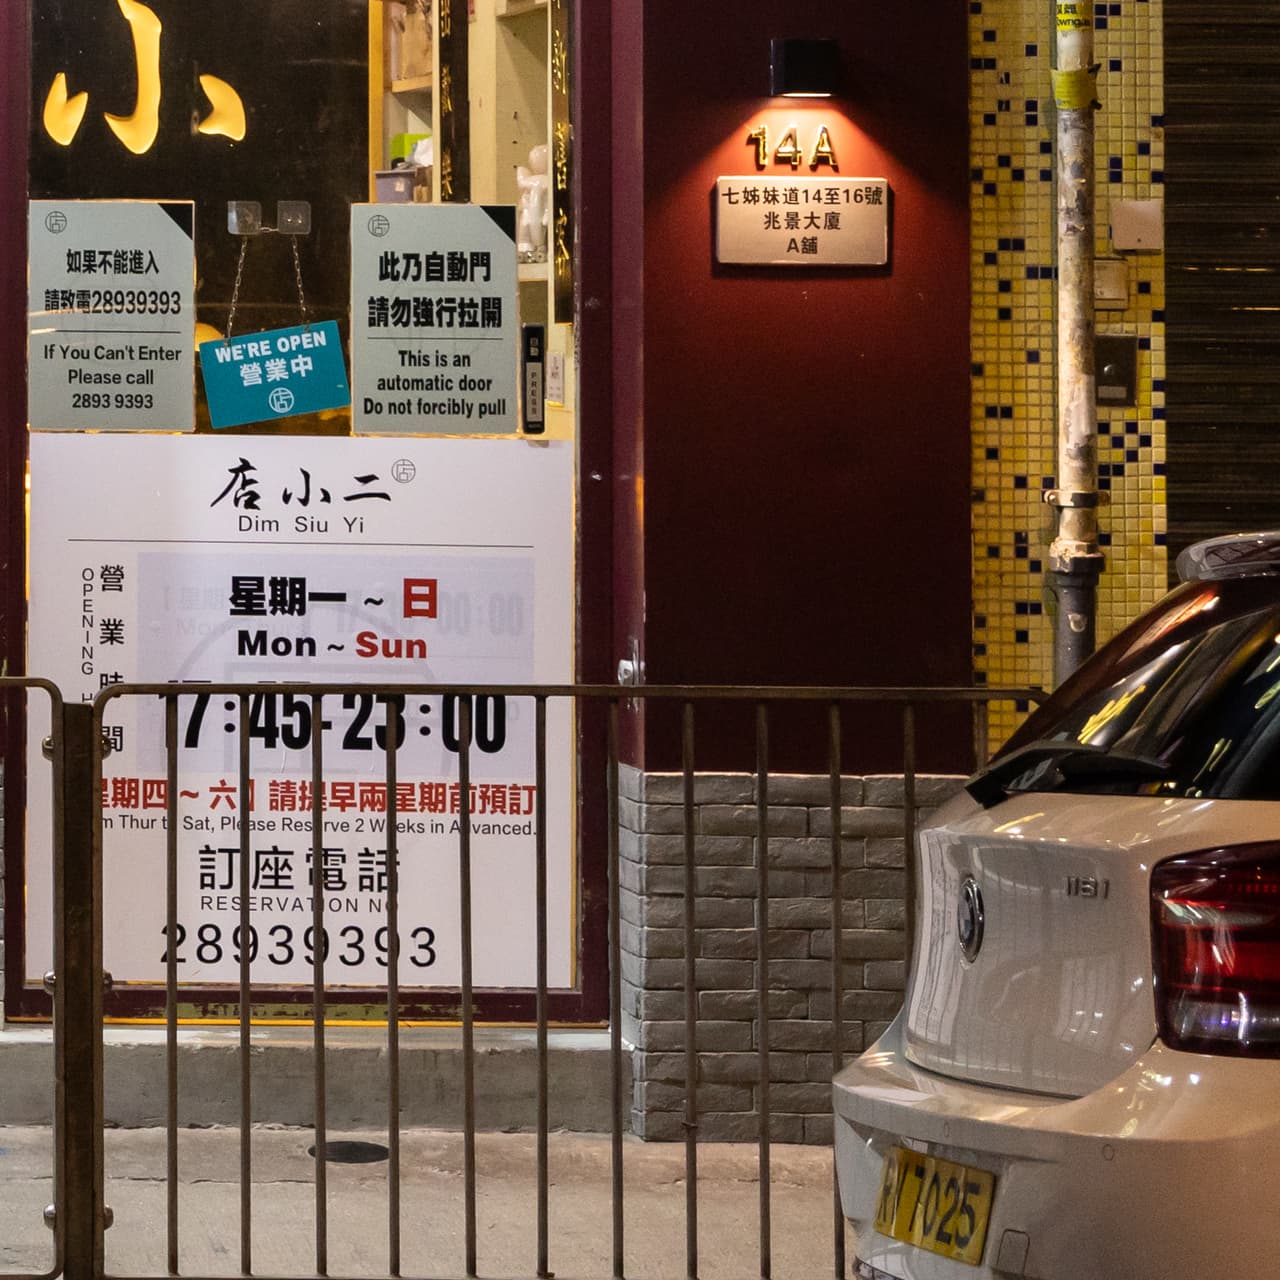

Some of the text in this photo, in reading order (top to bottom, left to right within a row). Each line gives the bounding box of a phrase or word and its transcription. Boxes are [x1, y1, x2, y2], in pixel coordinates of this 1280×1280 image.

[749, 123, 839, 169] 14A
[722, 186, 883, 206] 七姊妹道14至16號
[764, 211, 841, 231] 兆景大廈
[786, 236, 818, 255] A舖
[66, 248, 160, 276] 如果不能進入
[378, 251, 491, 283] 此乃自動門
[44, 288, 182, 316] 請致電28939393
[367, 296, 503, 329] 請勿強行拉開
[44, 345, 182, 362] If You Can't Enter
[215, 329, 328, 364] WE'RE OPEN
[398, 350, 471, 368] This is an
[68, 369, 154, 386] Please call
[238, 353, 315, 387] 營業中
[377, 375, 493, 392] automatic door
[71, 393, 154, 409] 2893 9393
[363, 398, 507, 419] Do not forcibly pull
[210, 457, 392, 510] 店小二
[237, 515, 365, 533] Dim Siu Yi
[228, 575, 347, 617] 星期一
[402, 578, 438, 619] 日
[237, 630, 317, 657] Mon
[355, 631, 427, 658] Sun
[119, 814, 159, 830] Thur
[182, 816, 215, 833] Sat,
[281, 817, 350, 833] Resrve
[355, 818, 365, 833] 2
[369, 819, 425, 834] Weks
[431, 819, 444, 834] in
[449, 820, 538, 836] Avanced.
[198, 844, 400, 893] 訂座電話
[160, 923, 437, 967] 28939393
